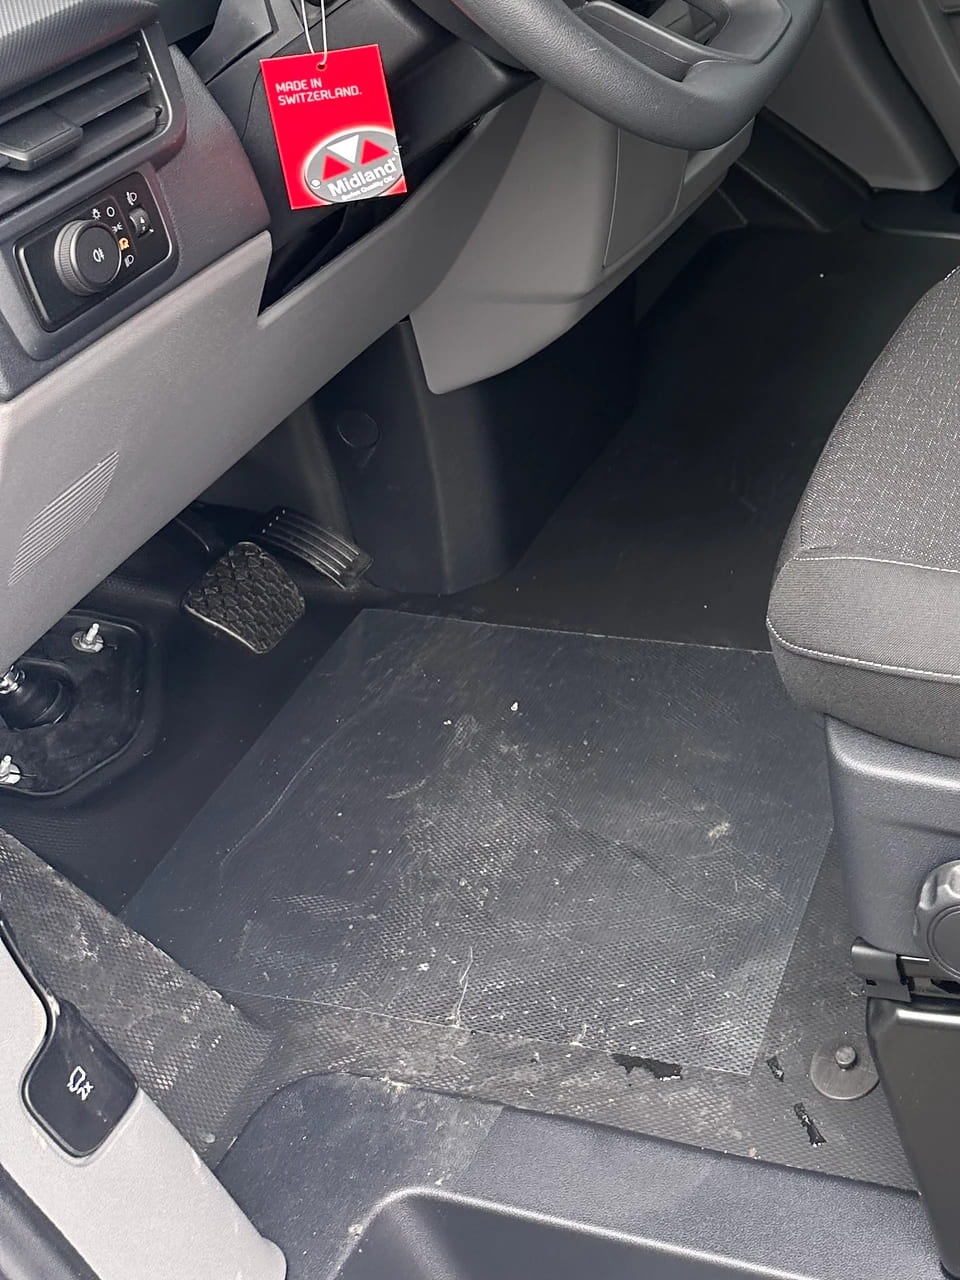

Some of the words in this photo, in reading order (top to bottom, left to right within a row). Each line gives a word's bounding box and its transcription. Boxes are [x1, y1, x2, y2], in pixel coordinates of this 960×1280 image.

[275, 79, 309, 94] MADE
[310, 77, 323, 89] IN
[277, 85, 363, 107] SWITZERLAND.
[327, 158, 397, 197] Midland
